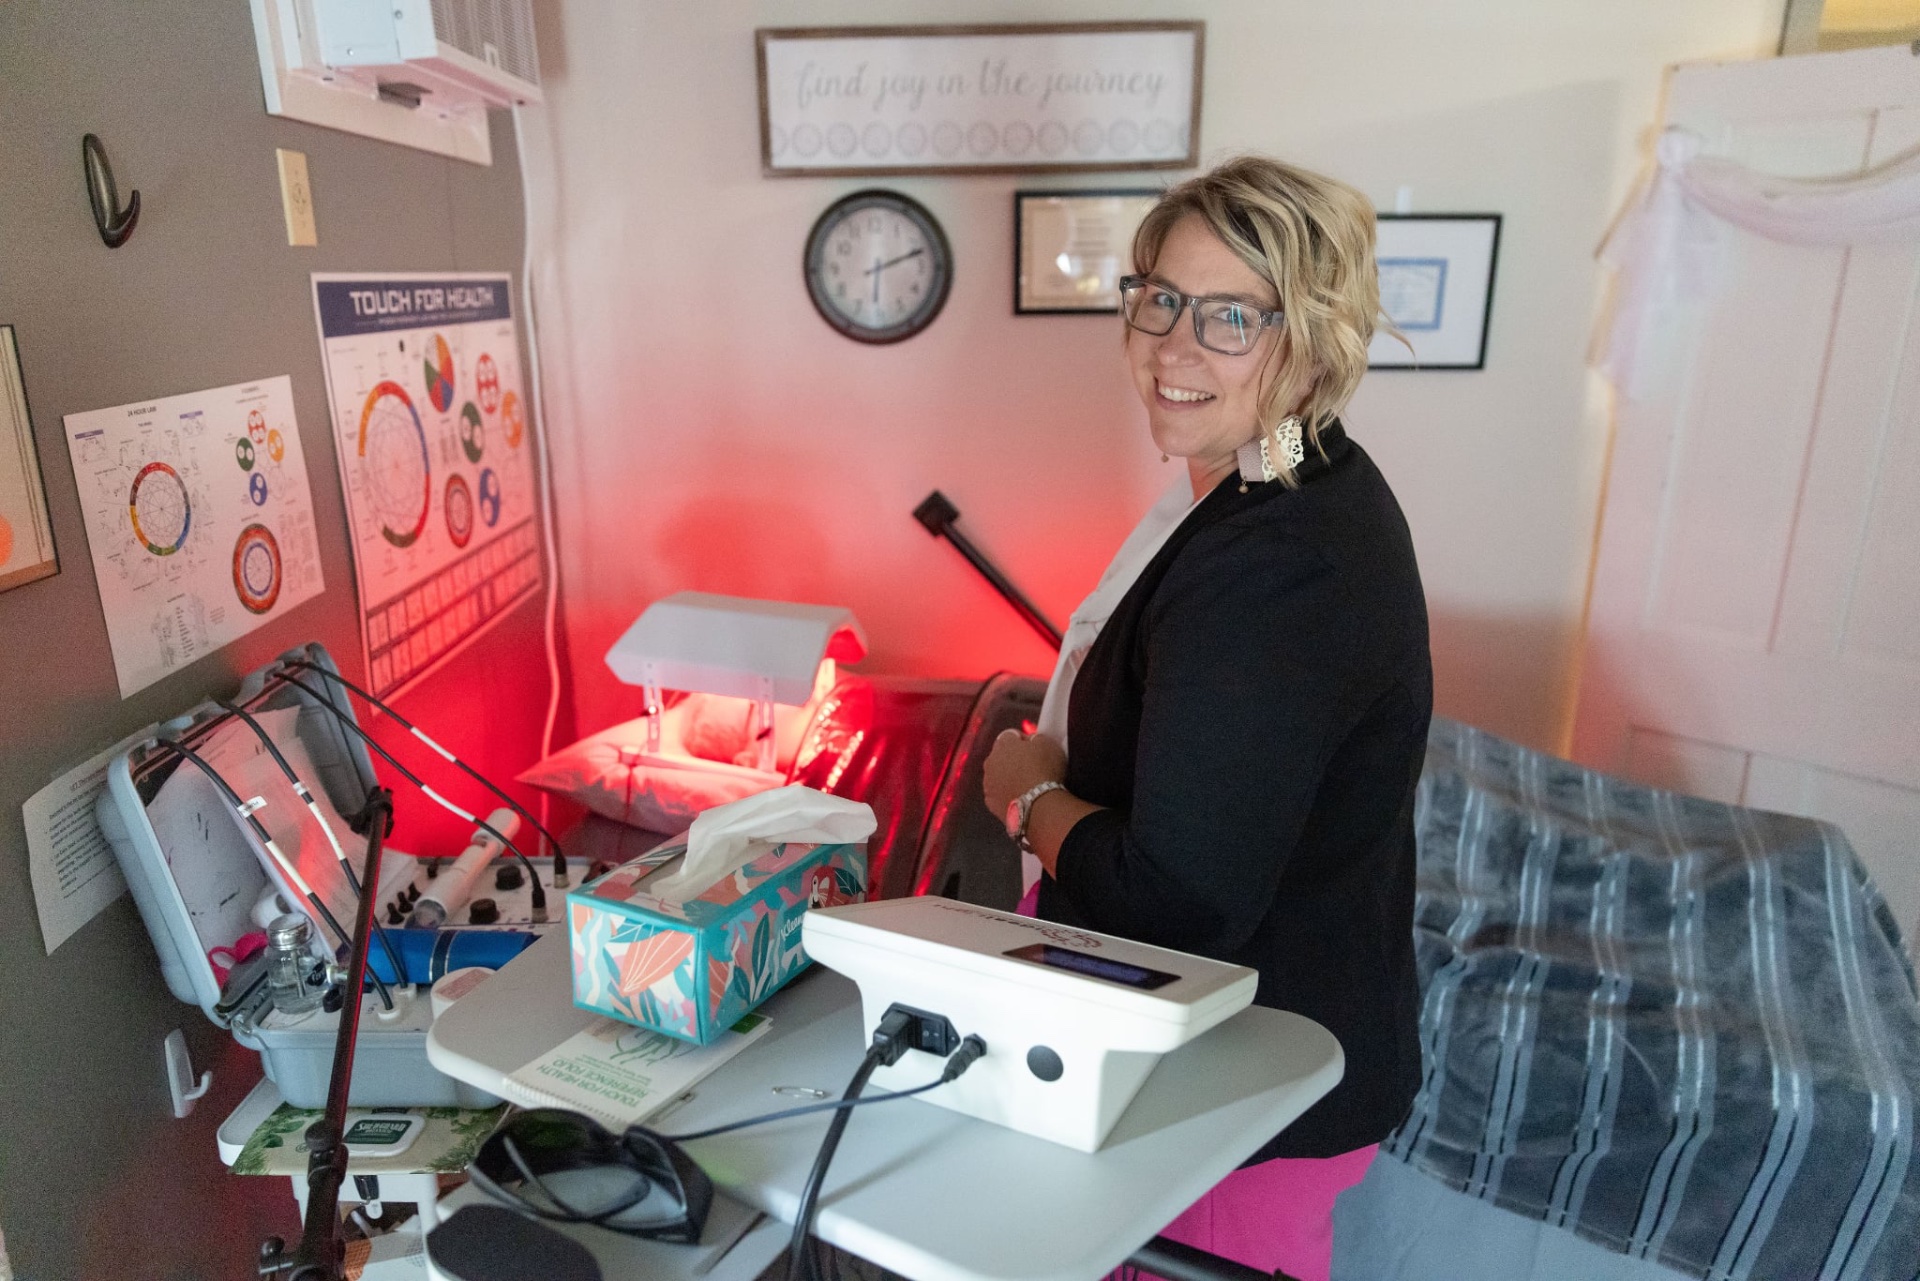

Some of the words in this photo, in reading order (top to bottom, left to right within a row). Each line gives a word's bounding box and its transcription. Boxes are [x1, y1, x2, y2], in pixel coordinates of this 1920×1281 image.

[797, 60, 870, 110] find
[872, 70, 927, 111] joy
[936, 73, 966, 95] in
[979, 58, 1033, 96] the
[1037, 70, 1166, 111] journey
[349, 290, 412, 316] TOUCH
[414, 288, 445, 312] FOR
[447, 286, 495, 310] HEALTH
[780, 912, 804, 943] Kleen
[536, 1063, 578, 1085] HEALTH
[577, 1080, 603, 1094] FOR
[586, 1070, 650, 1100] REFERENCE
[600, 1088, 639, 1108] TOUCH
